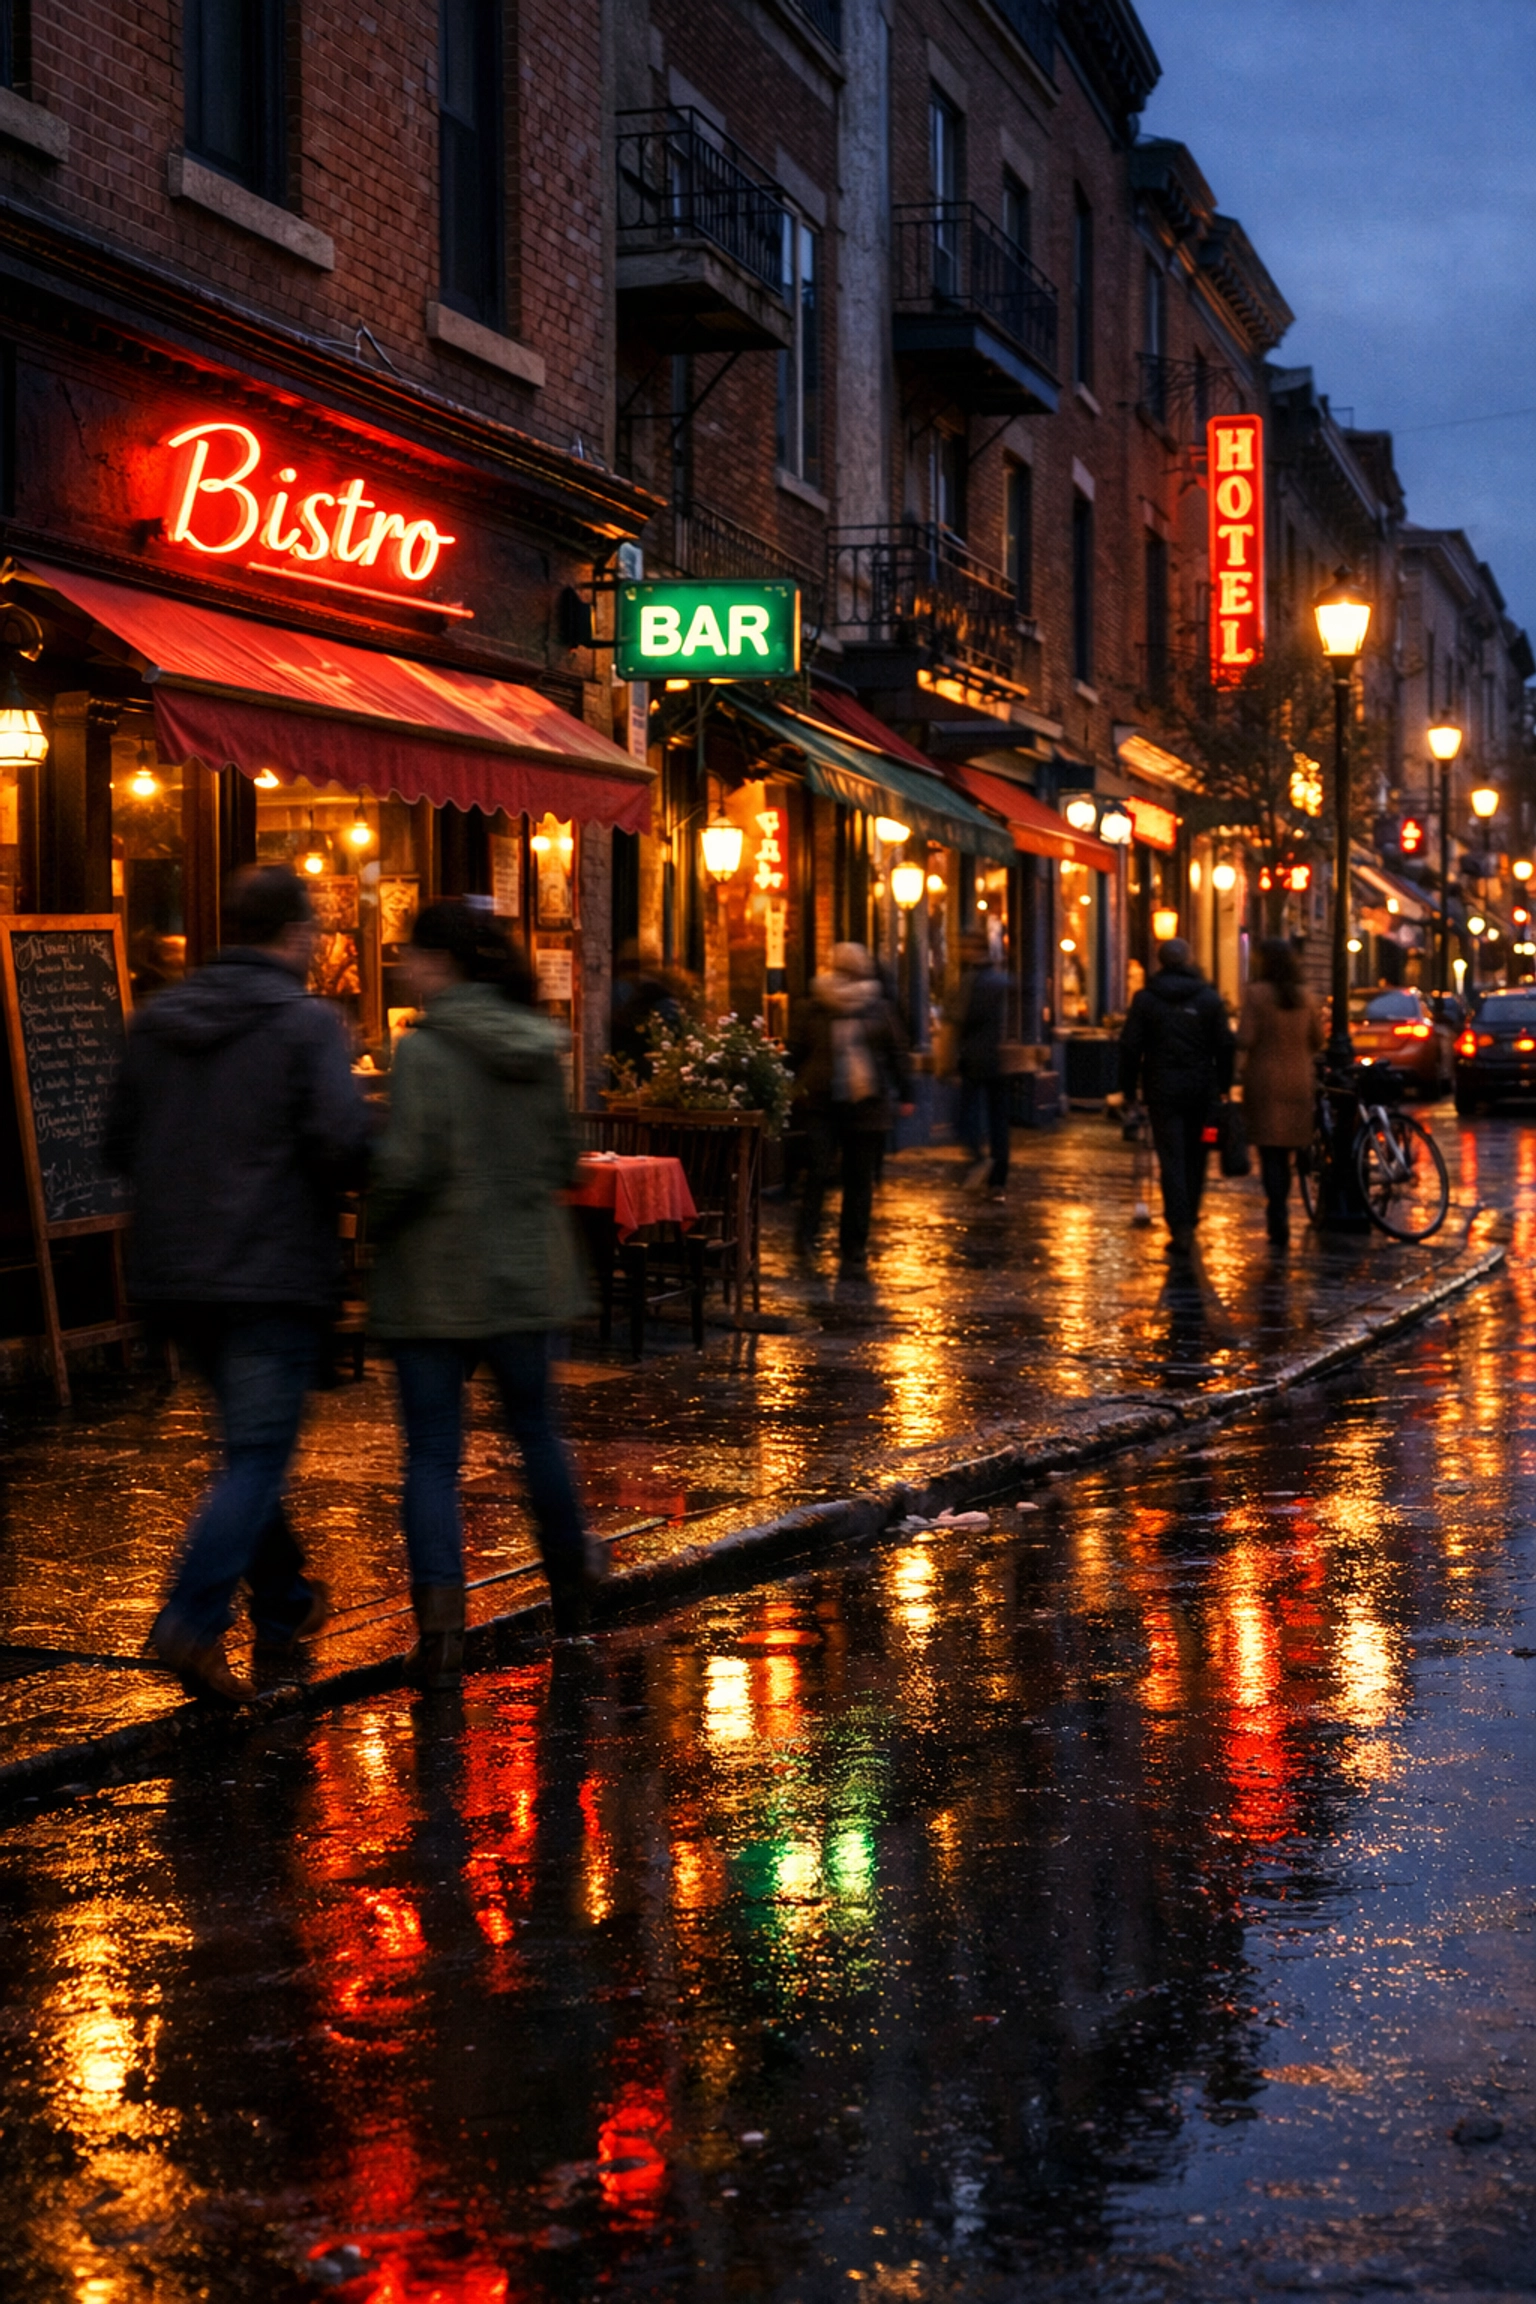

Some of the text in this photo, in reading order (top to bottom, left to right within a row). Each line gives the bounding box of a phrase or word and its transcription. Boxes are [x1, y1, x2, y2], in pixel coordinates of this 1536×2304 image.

[167, 422, 456, 581] Bistro
[1216, 428, 1255, 664] HOTEL
[640, 604, 770, 656] BAR
